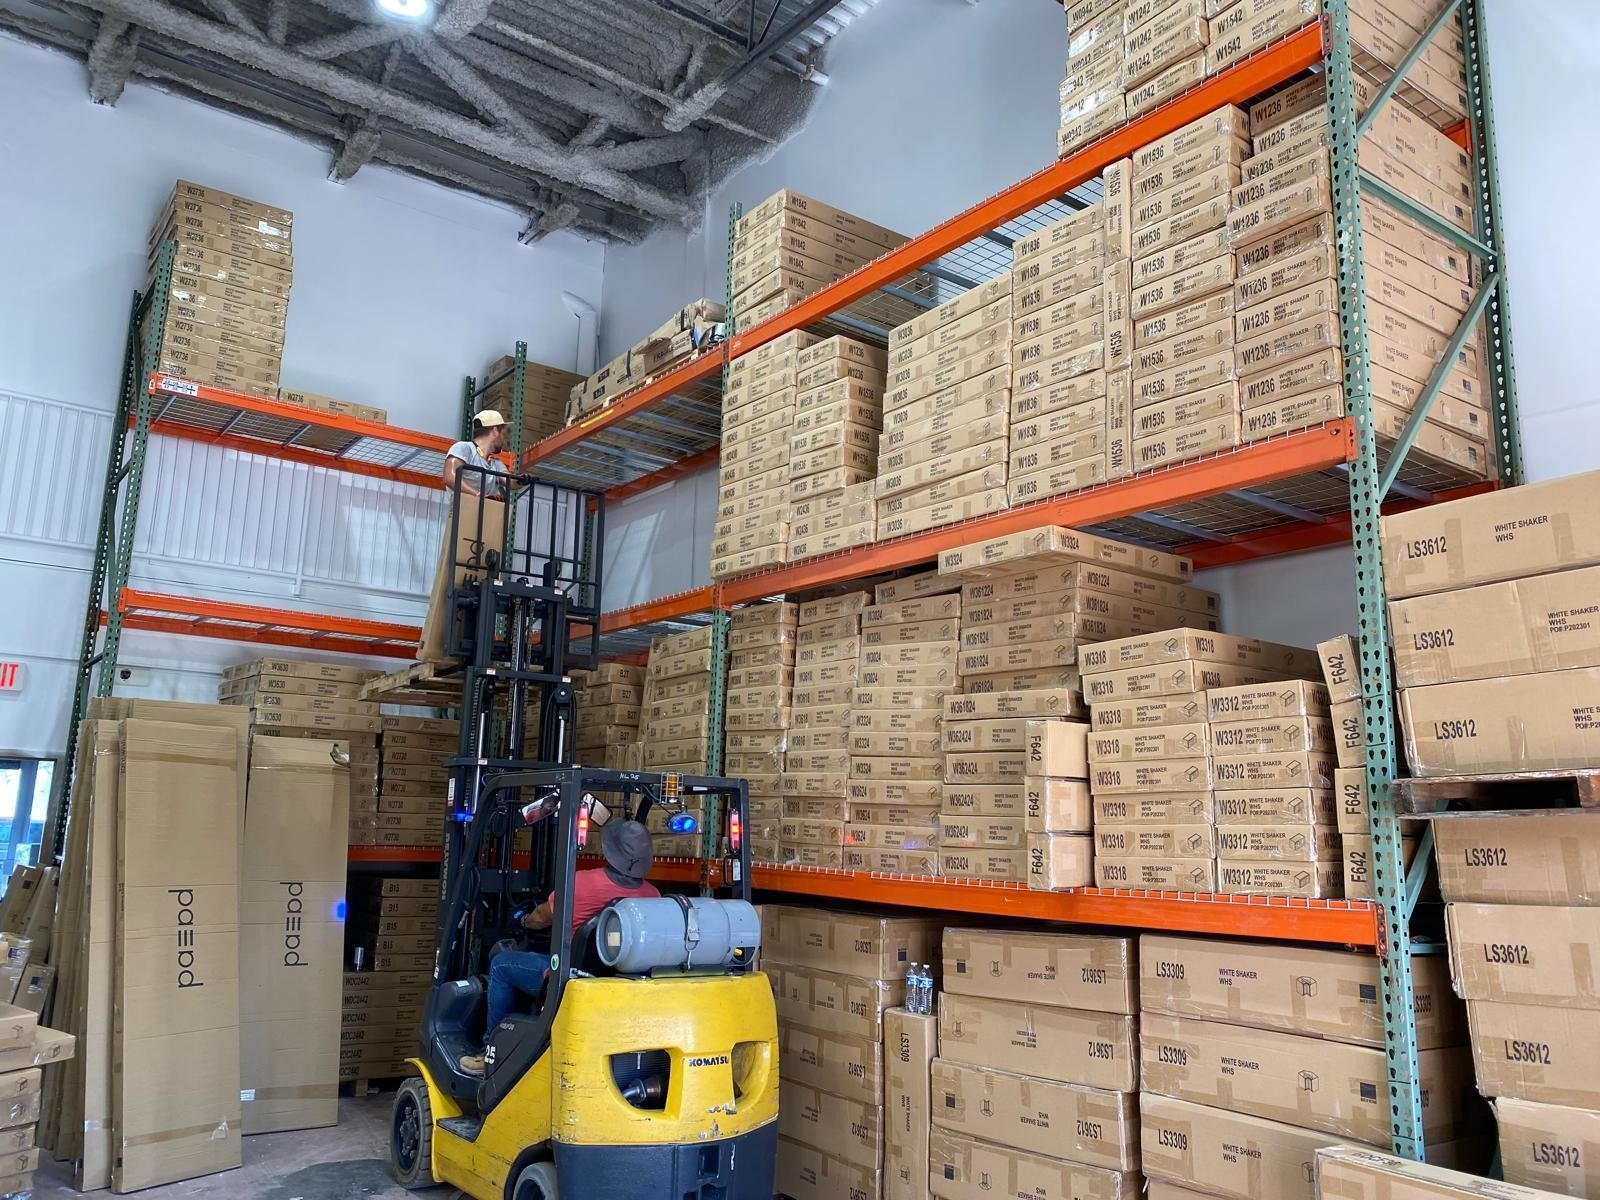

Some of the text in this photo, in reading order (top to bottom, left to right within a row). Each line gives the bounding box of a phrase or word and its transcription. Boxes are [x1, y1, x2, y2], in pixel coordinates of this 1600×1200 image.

[1128, 5, 1150, 27] W1242
[1217, 10, 1243, 34] W1542
[1129, 30, 1152, 51] W1242
[1216, 36, 1242, 61] W1542
[1128, 53, 1150, 75] W1242
[1132, 84, 1155, 106] W1242
[1255, 100, 1282, 122] W1236
[1258, 128, 1286, 151] W1236
[1141, 145, 1164, 166] W1536
[1139, 202, 1162, 222] W1536
[1243, 245, 1269, 265] W1236
[1021, 264, 1040, 280] W1836
[1141, 256, 1165, 275] W1536
[1242, 310, 1269, 331] W1236
[1020, 345, 1040, 361] W1836
[1140, 349, 1164, 368] W1536
[1242, 343, 1270, 364] W1236
[1247, 378, 1275, 399] W1236
[1018, 397, 1037, 415] W1836
[1141, 412, 1165, 429] W1536
[1248, 412, 1277, 431] W1236
[1018, 424, 1037, 440] W1836
[1018, 453, 1038, 469] W1836
[1112, 439, 1123, 468] W1536
[887, 518, 902, 532] W3036
[1494, 515, 1548, 532] WHITE SHAKER
[1060, 535, 1079, 550] W3324
[1496, 532, 1514, 542] WHS
[1408, 536, 1447, 559] LS3612
[944, 552, 962, 568] W3324
[1087, 572, 1110, 588] W361224
[970, 584, 993, 599] W361224
[1086, 597, 1108, 613] W361824
[1548, 606, 1599, 619] WHITE SHAKER
[1549, 618, 1566, 626] WHS
[966, 632, 989, 646] W361824
[1195, 637, 1214, 653] W3318
[1414, 629, 1454, 650] LS3612
[965, 654, 988, 668] W361824
[1084, 651, 1107, 666] W3318
[0, 662, 19, 688] IT
[1328, 652, 1346, 686] F642
[1090, 680, 1114, 696] W3318
[950, 699, 975, 713] W361824
[1211, 696, 1240, 712] W3312
[1572, 707, 1594, 715] WHITE
[1098, 709, 1122, 724] W3318
[947, 731, 972, 743] W362424
[1216, 729, 1243, 746] W3312
[1346, 716, 1359, 749] F642
[1434, 720, 1476, 740] LS3612
[1030, 735, 1041, 761] F642
[1096, 738, 1120, 754] W3318
[952, 762, 977, 774] W362424
[1216, 763, 1244, 780] W3312
[1097, 770, 1121, 786] W3318
[950, 794, 973, 807] W362424
[1029, 791, 1039, 818] F642
[1219, 797, 1247, 816] W3312
[1346, 783, 1360, 815] F642
[1102, 801, 1126, 817] W3318
[945, 825, 969, 838] W362424
[1100, 832, 1124, 848] W3318
[1220, 832, 1248, 850] W3312
[945, 857, 969, 870] W362424
[1032, 848, 1043, 875] F642
[1464, 848, 1507, 867] LS3612
[1102, 864, 1127, 881] W3318
[1351, 851, 1367, 883] F642
[1223, 868, 1251, 885] W3312
[855, 940, 872, 954] LS3612
[1483, 944, 1529, 964] LS3612
[1082, 968, 1106, 984] LS3612
[1156, 961, 1184, 980] LS3309
[1219, 968, 1258, 980] WHITE SHAKER
[1219, 978, 1232, 986] WHS
[851, 1002, 866, 1016] LS3612
[901, 1033, 909, 1062] LS3309
[1089, 1042, 1113, 1059] LS3612
[1158, 1045, 1187, 1066] LS3309
[1505, 1040, 1551, 1065] LS3612
[848, 1062, 866, 1079] LS3612
[1221, 1056, 1259, 1070] WHITE SHAKER
[1221, 1066, 1234, 1076] WHS
[851, 1123, 868, 1140] LS3612
[1077, 1120, 1102, 1139] LS3612
[1158, 1128, 1188, 1150] LS3309
[1222, 1143, 1262, 1159] WHITE SHAKER
[1223, 1153, 1237, 1163] WHS
[1533, 1143, 1580, 1167] LS3612
